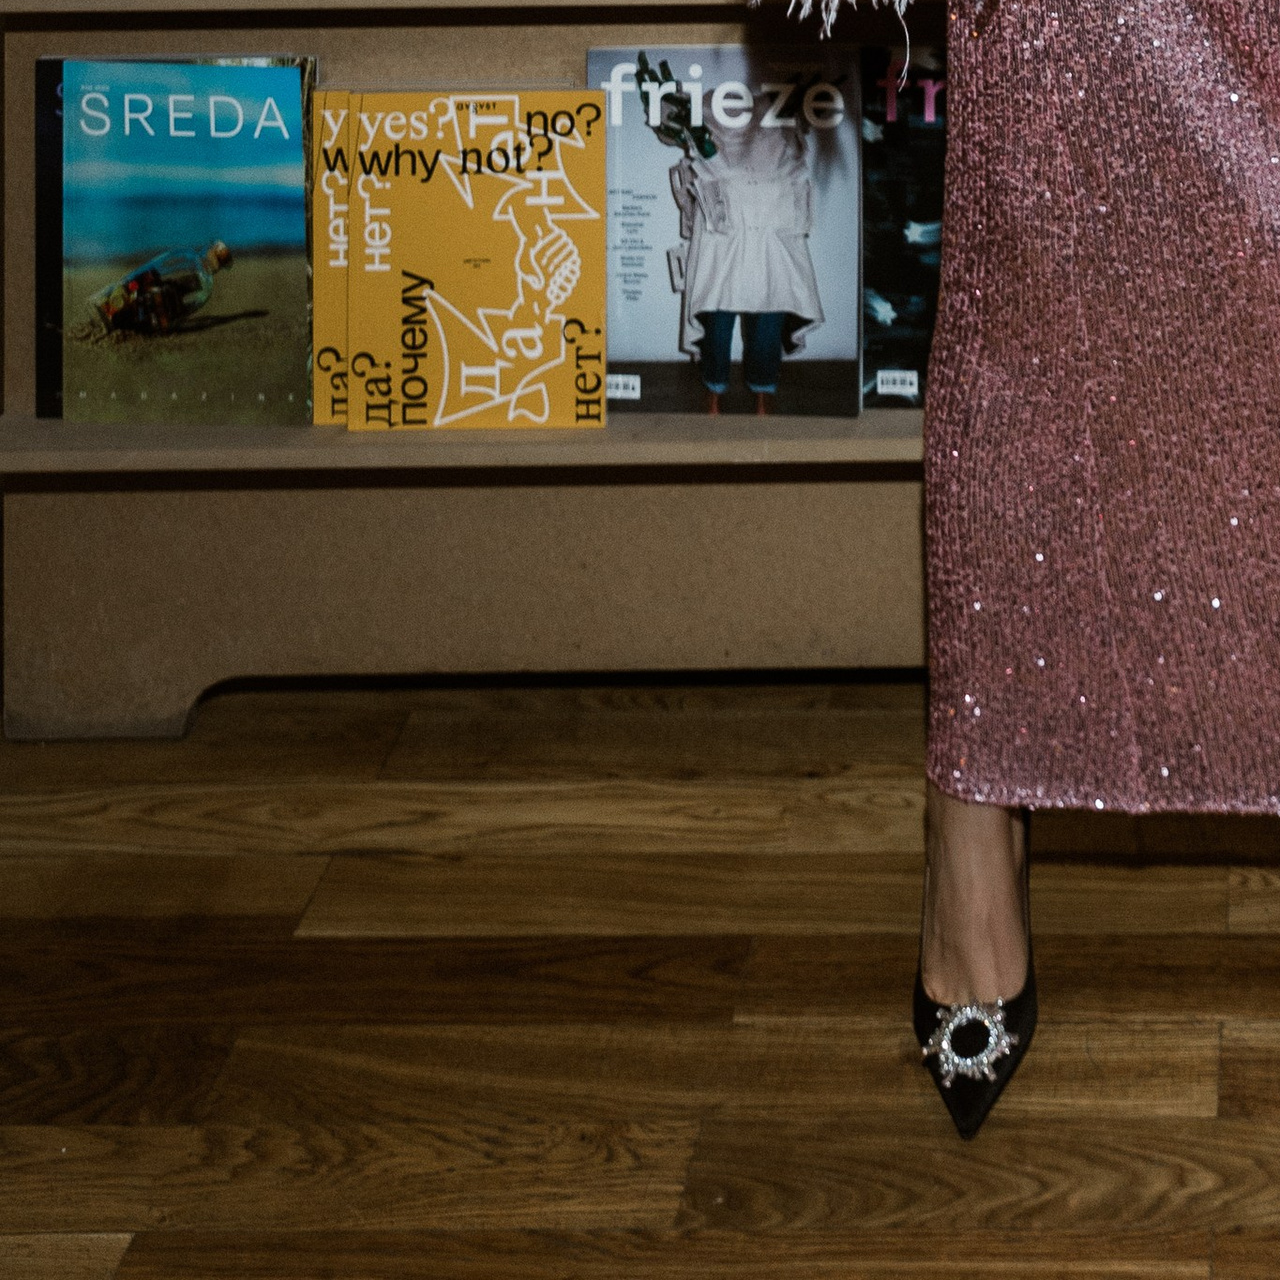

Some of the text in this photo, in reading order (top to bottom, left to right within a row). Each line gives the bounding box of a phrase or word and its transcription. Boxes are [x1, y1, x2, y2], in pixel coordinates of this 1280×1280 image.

[80, 93, 291, 141] SREDA
[358, 97, 602, 152] yes? no?
[600, 63, 846, 129] frieze
[358, 133, 554, 183] why not?
[401, 269, 435, 427] почему
[562, 317, 602, 424] нет?
